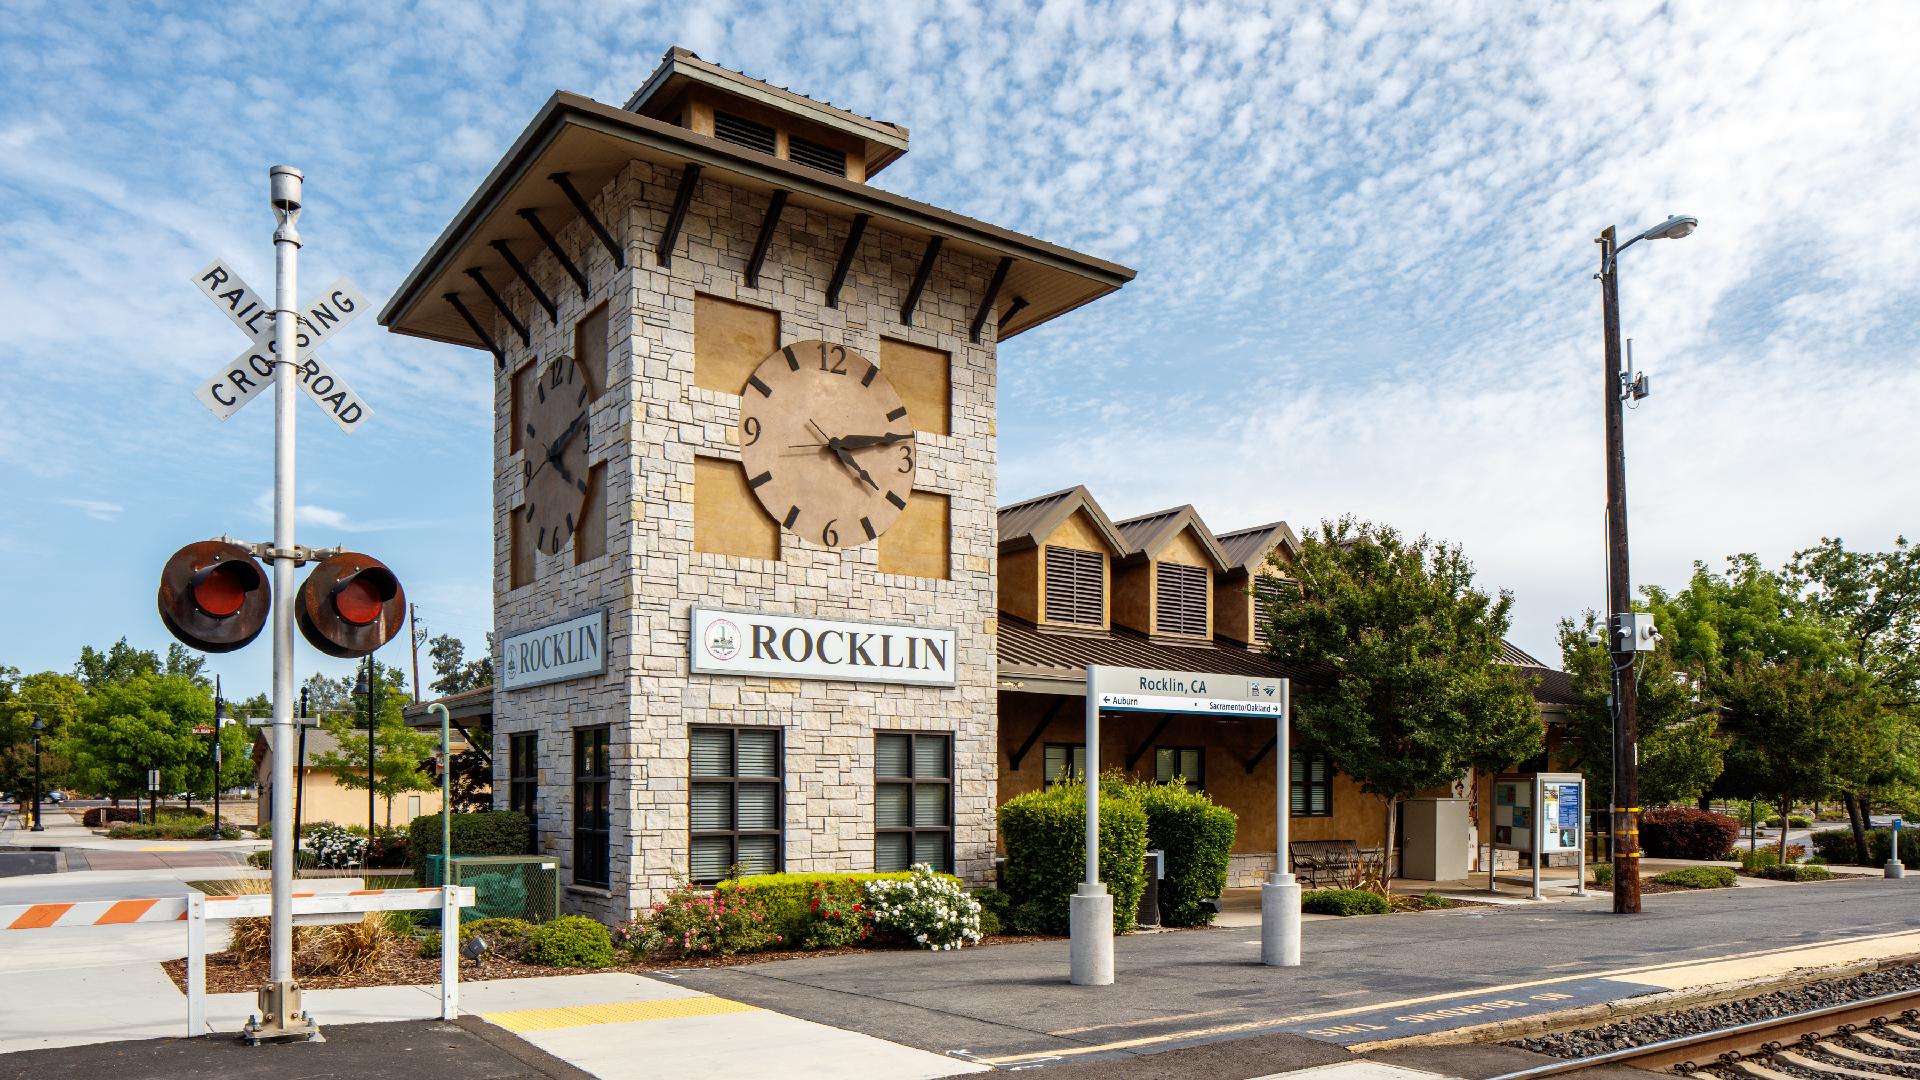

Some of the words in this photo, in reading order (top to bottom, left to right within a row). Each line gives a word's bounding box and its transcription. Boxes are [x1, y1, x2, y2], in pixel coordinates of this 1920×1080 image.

[202, 266, 265, 334] RAIL
[551, 356, 563, 390] 12
[817, 343, 847, 376] 12
[303, 359, 362, 424] ROAD
[744, 416, 761, 447] 9
[525, 461, 531, 488] 9
[898, 446, 914, 474] 3
[552, 526, 559, 554] 6
[822, 519, 838, 548] 6
[519, 623, 598, 674] ROCKLIN
[748, 623, 949, 672] ROCKLIN
[1139, 676, 1188, 694] Rocklin,
[1191, 680, 1207, 694] CA
[1112, 696, 1138, 706] Auburn
[1209, 702, 1271, 713] Sacramento/Oakland
